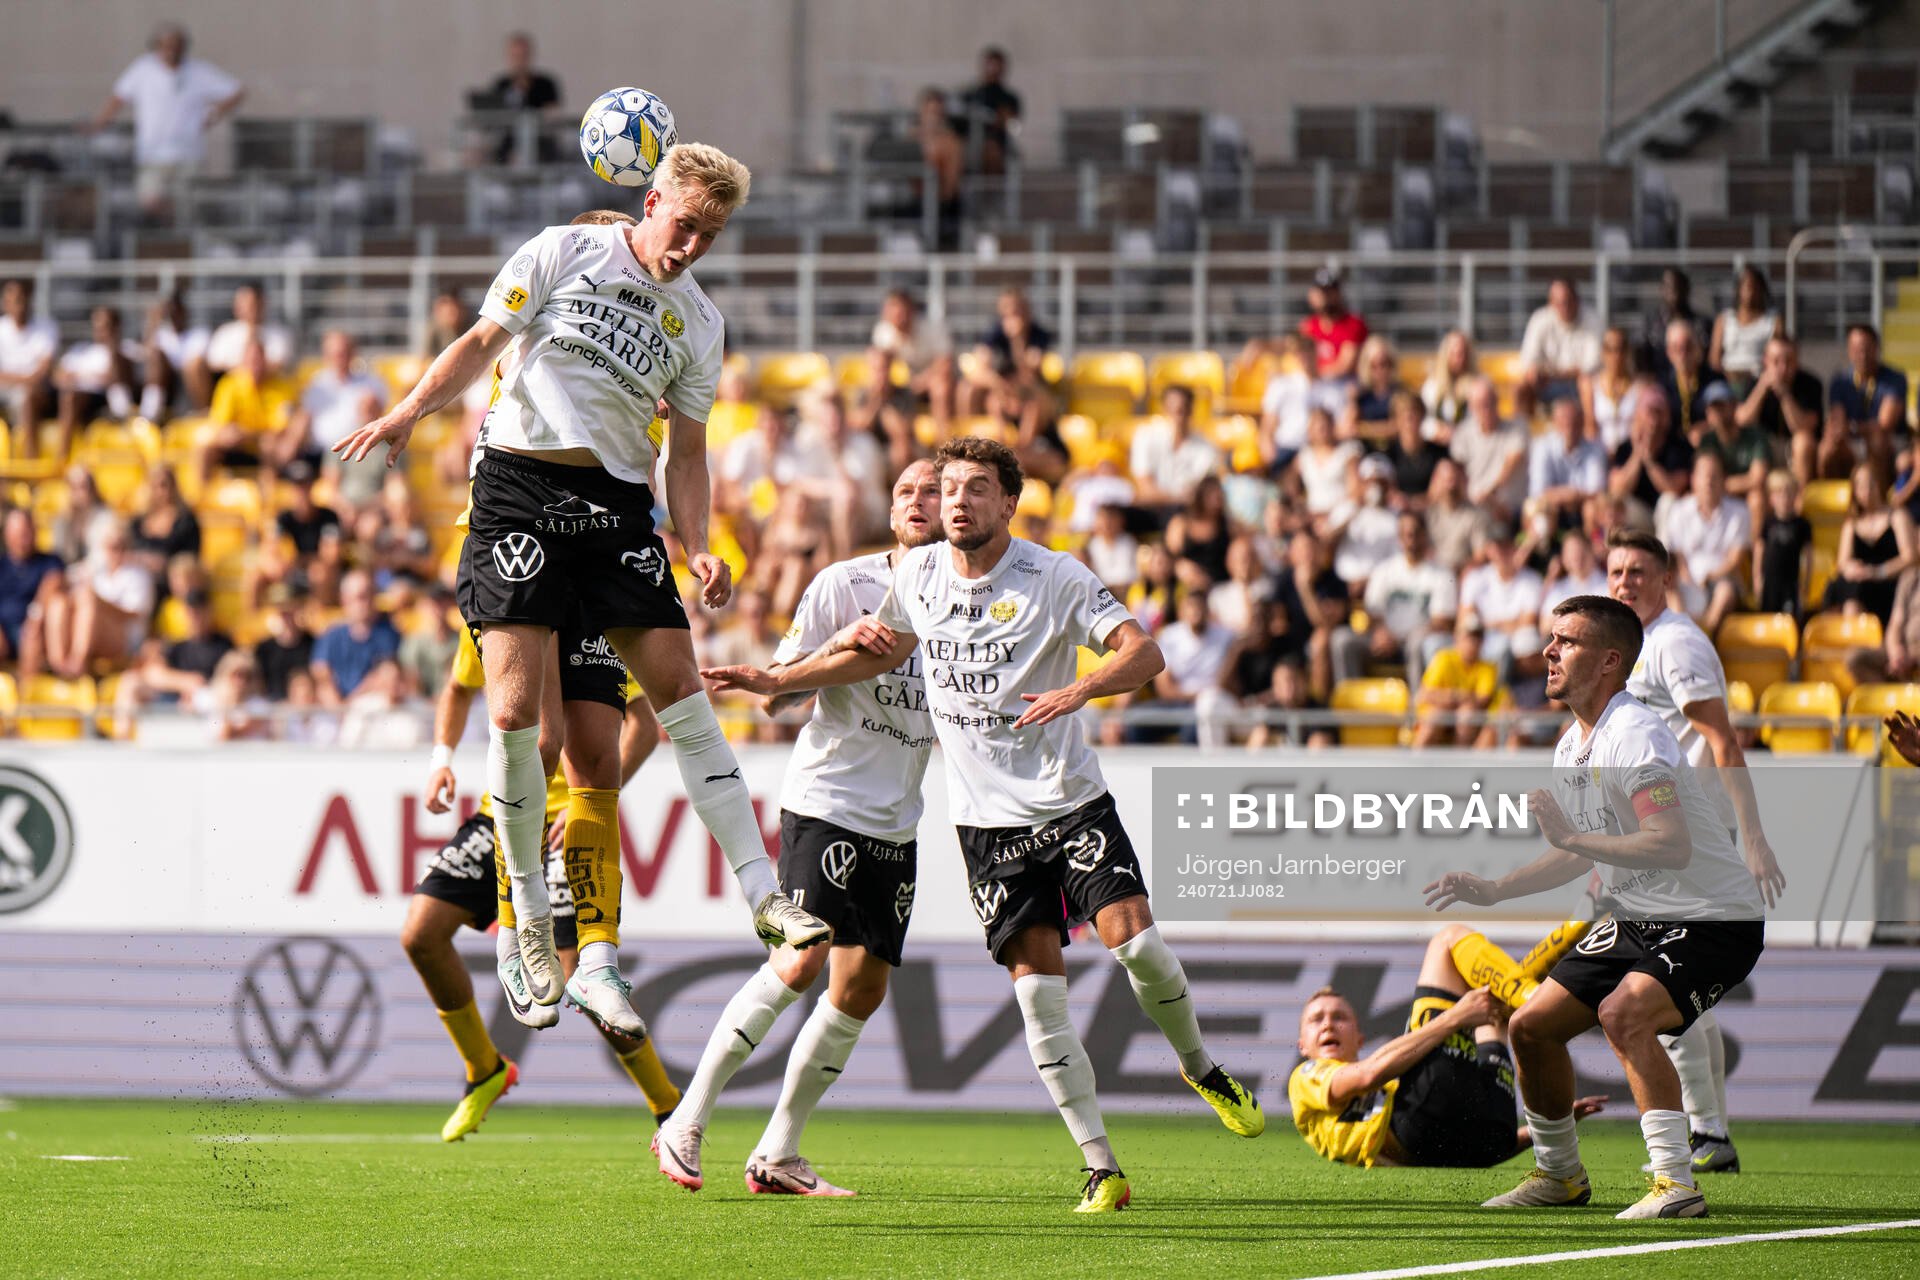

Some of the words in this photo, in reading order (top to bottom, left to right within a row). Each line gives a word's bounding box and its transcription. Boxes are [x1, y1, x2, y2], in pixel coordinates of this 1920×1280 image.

[617, 288, 657, 314] MAXI
[579, 322, 652, 377] GÅRD
[535, 515, 621, 535] SÄLJFAST
[951, 603, 983, 618] MAXI
[919, 637, 1018, 663] MELLBY
[933, 664, 999, 694] GÅRD
[874, 681, 931, 712] GÅR
